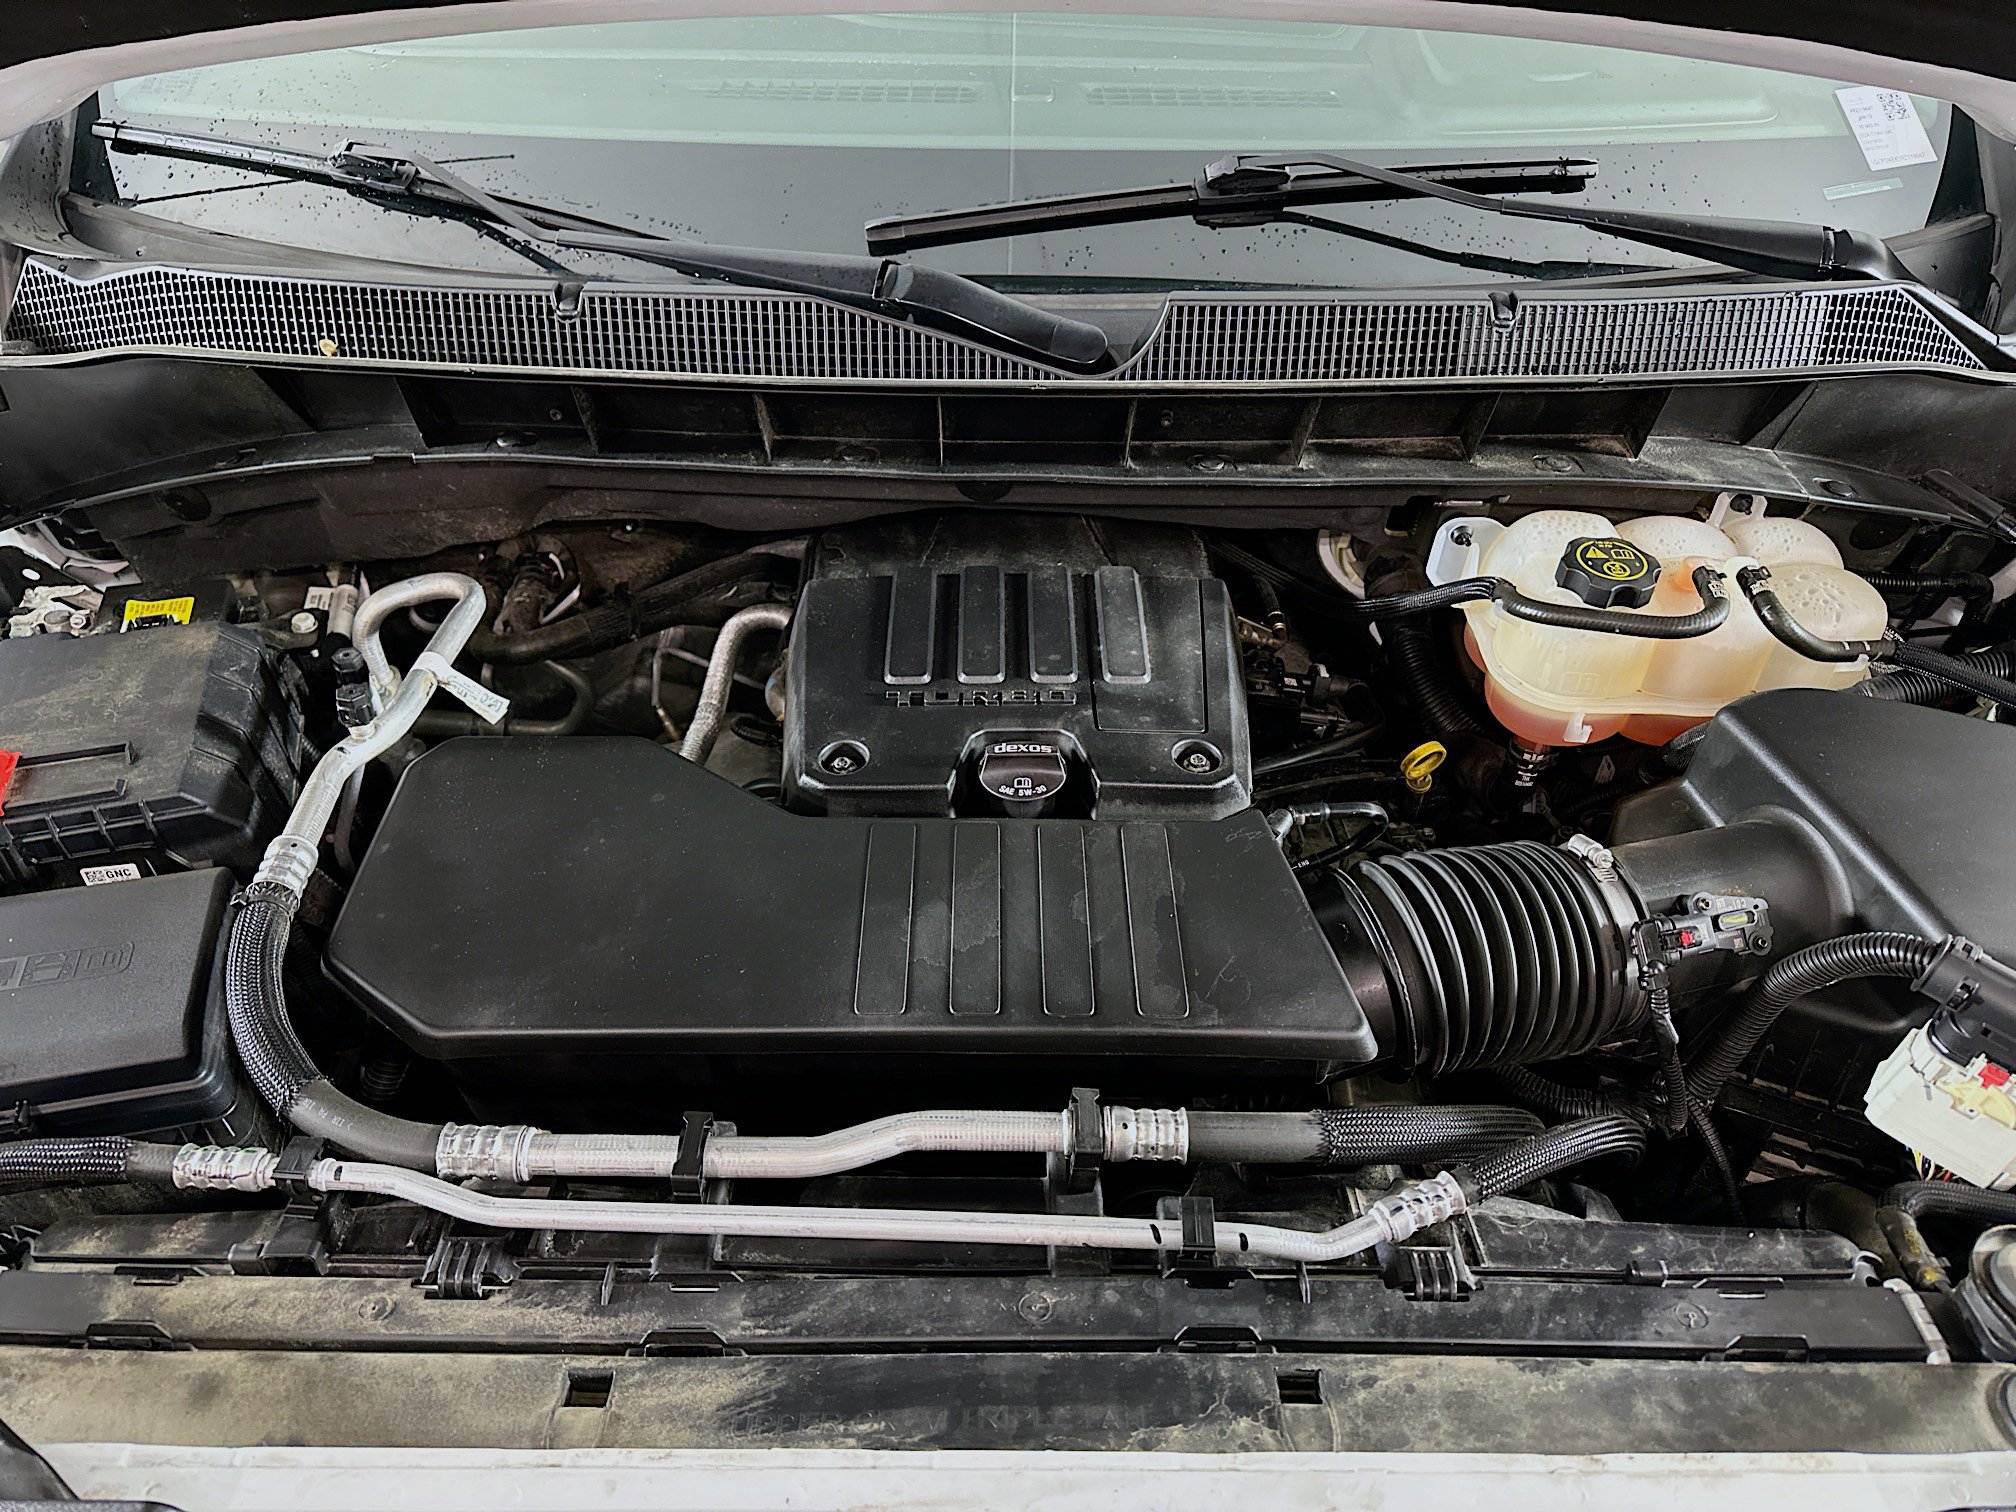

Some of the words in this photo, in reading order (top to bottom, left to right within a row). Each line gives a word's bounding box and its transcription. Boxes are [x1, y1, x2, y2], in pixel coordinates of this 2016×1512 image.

[886, 690, 1076, 707] TURBO
[994, 742, 1053, 754] dexos
[998, 785, 1015, 797] SAE
[1018, 784, 1048, 797] 5W-30
[105, 868, 132, 879] GNC
